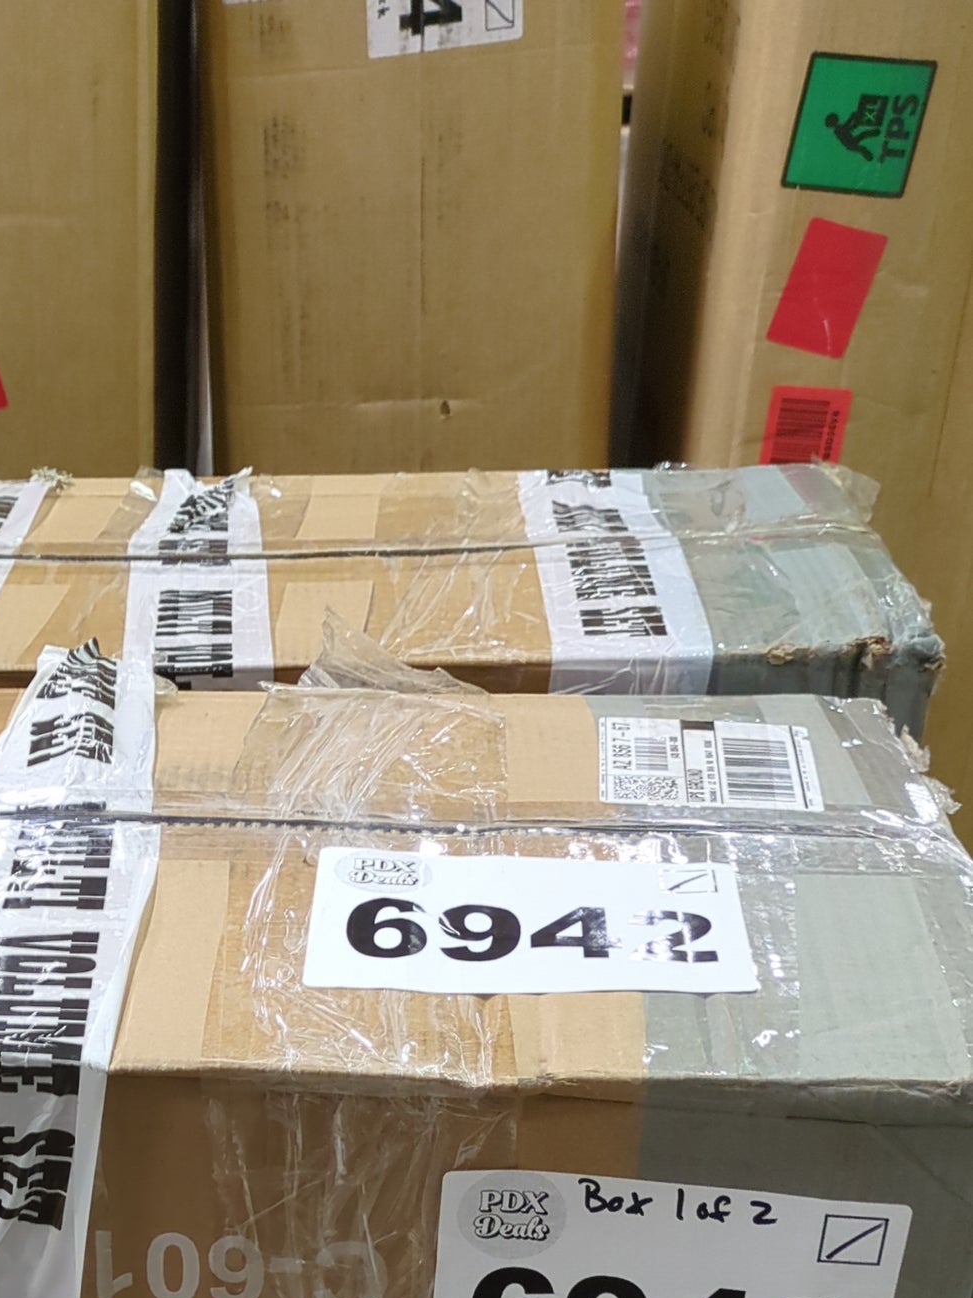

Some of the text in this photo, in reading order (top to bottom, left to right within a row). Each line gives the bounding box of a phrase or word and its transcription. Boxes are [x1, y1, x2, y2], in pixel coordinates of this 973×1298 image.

[879, 94, 920, 164] TPS
[155, 590, 233, 636] MULTI
[579, 606, 668, 637] SET
[352, 857, 418, 875] PDX
[345, 897, 719, 964] 6942
[479, 1190, 550, 1216] PDX
[578, 1178, 654, 1218] Box
[696, 1195, 732, 1223] of
[750, 1202, 778, 1226] 2
[473, 1215, 551, 1241] Deals
